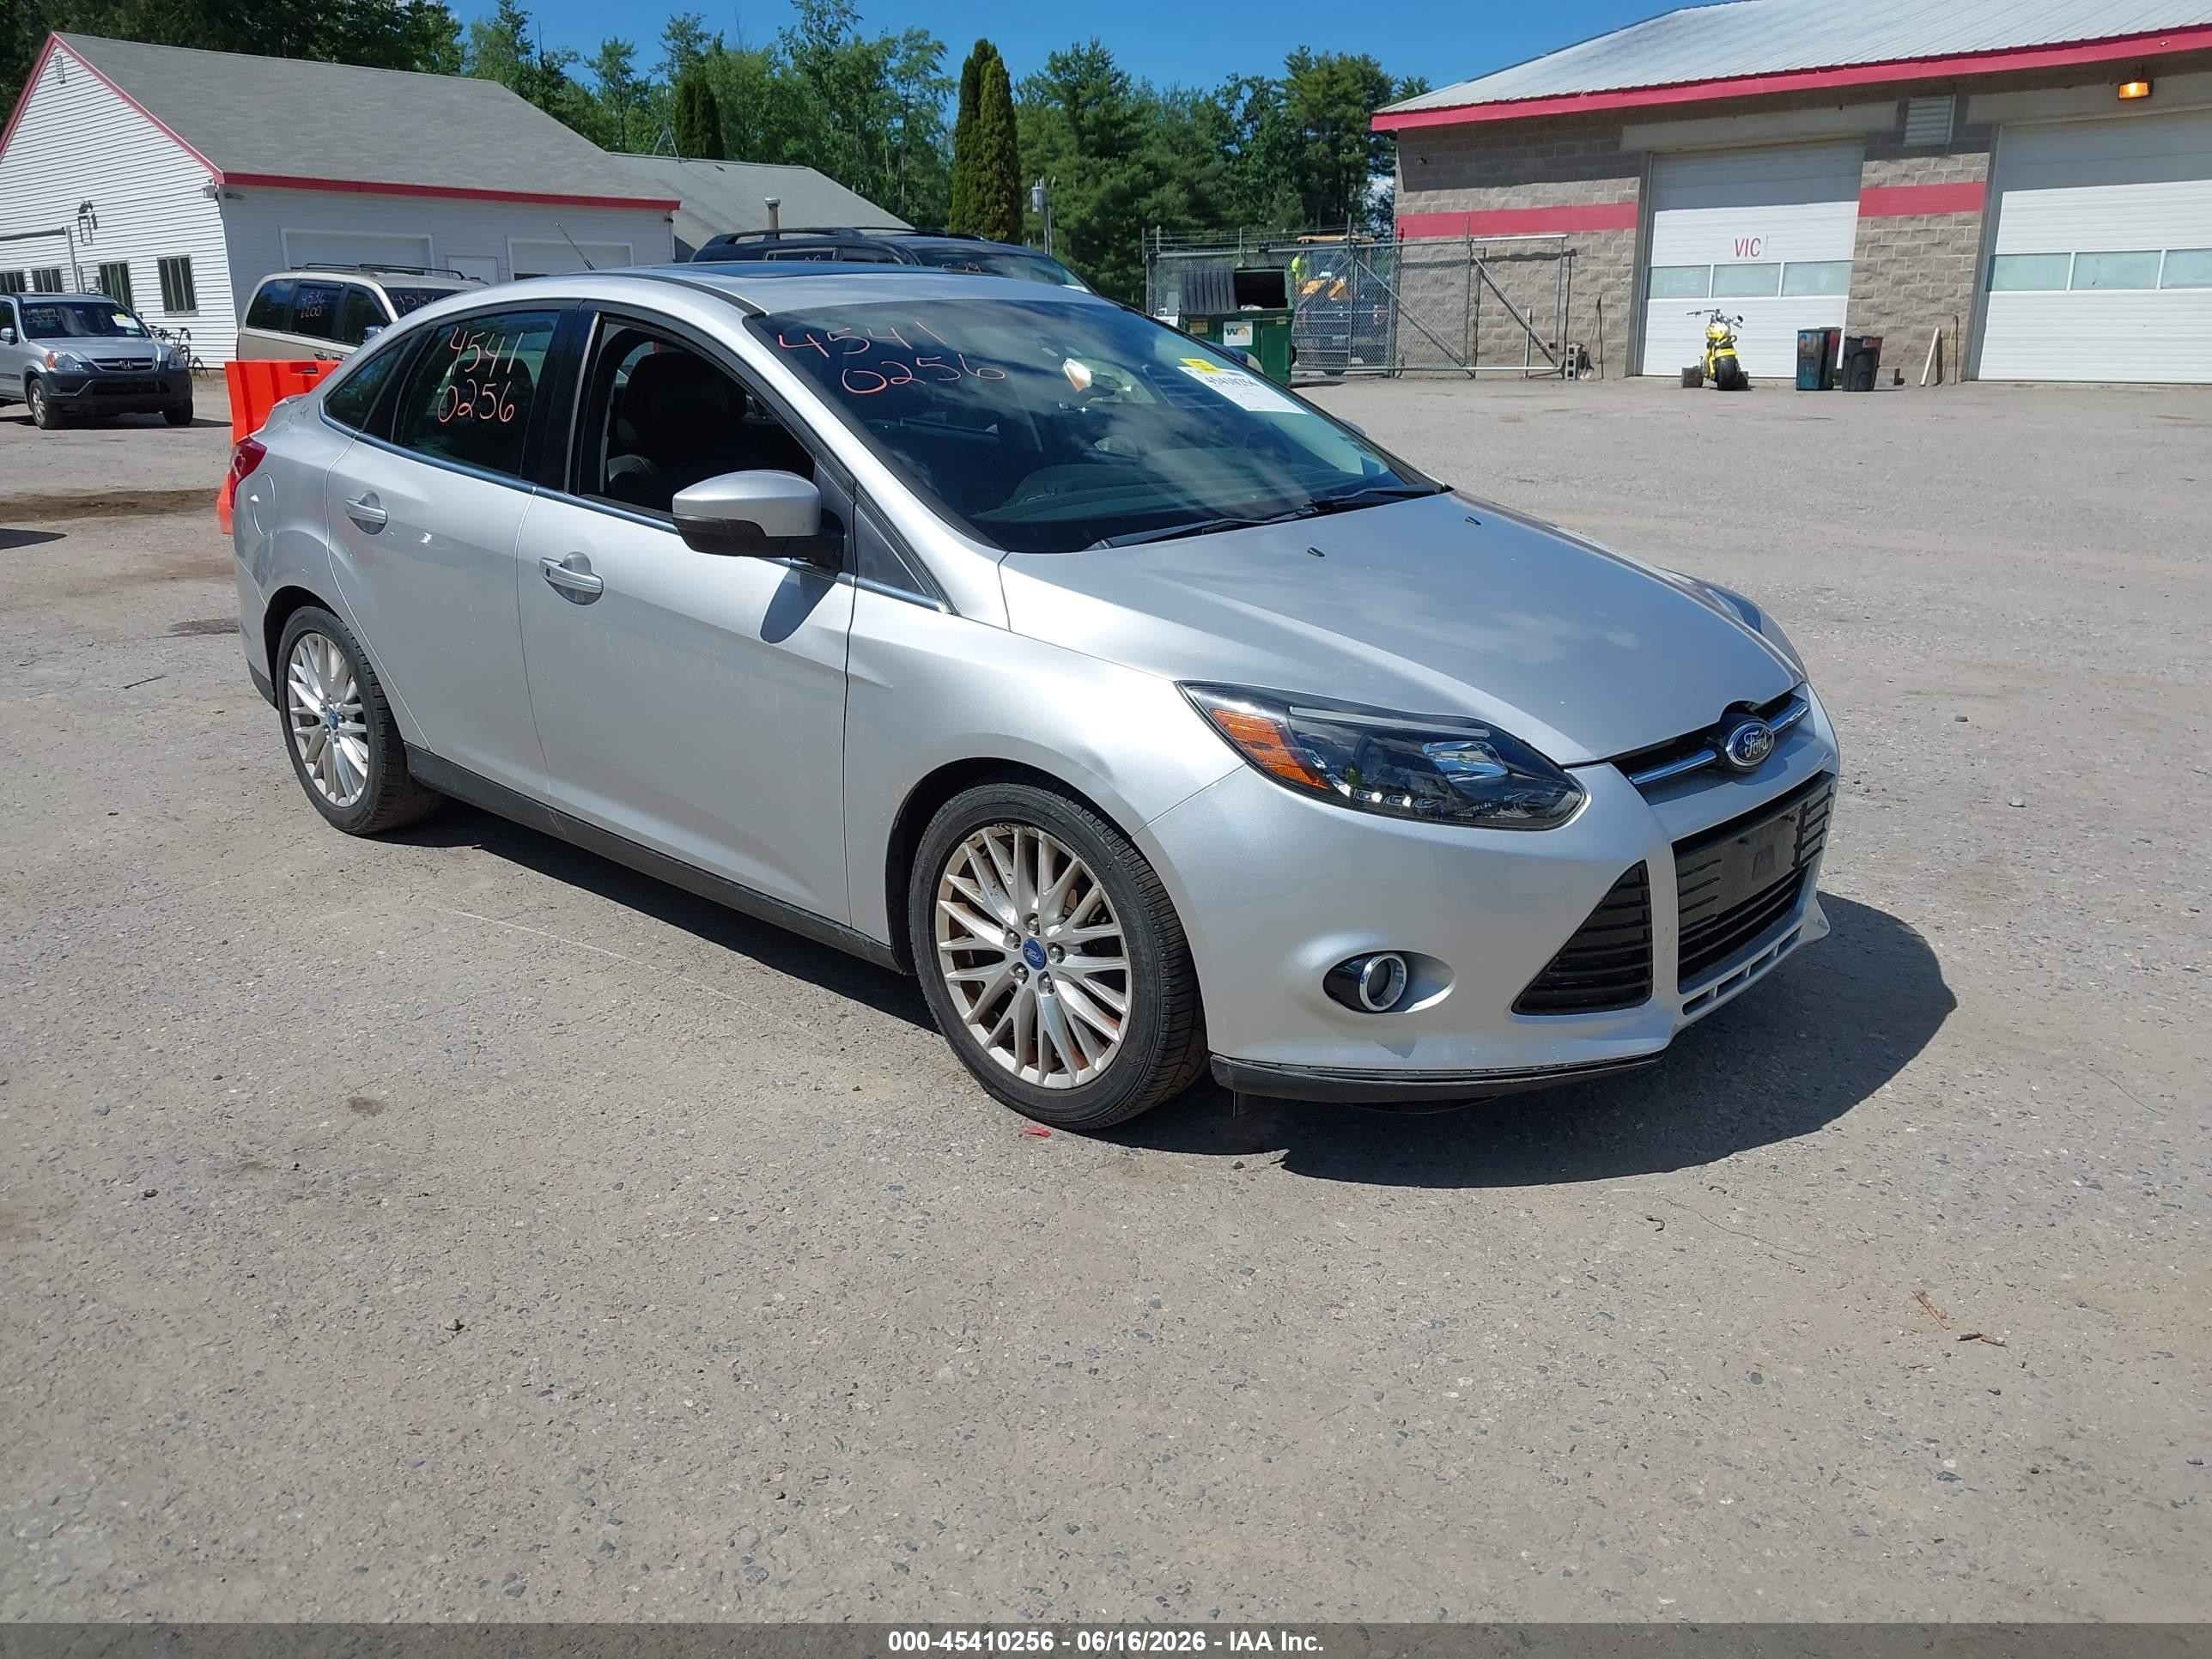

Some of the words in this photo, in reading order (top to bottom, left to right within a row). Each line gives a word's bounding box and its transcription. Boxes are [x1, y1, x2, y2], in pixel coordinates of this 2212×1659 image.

[1735, 237, 1761, 258] VIC
[450, 326, 524, 378] 4541
[779, 321, 947, 358] 4541
[842, 353, 1006, 394] 0256
[438, 379, 515, 422] 0256
[1744, 730, 1769, 758] Ford
